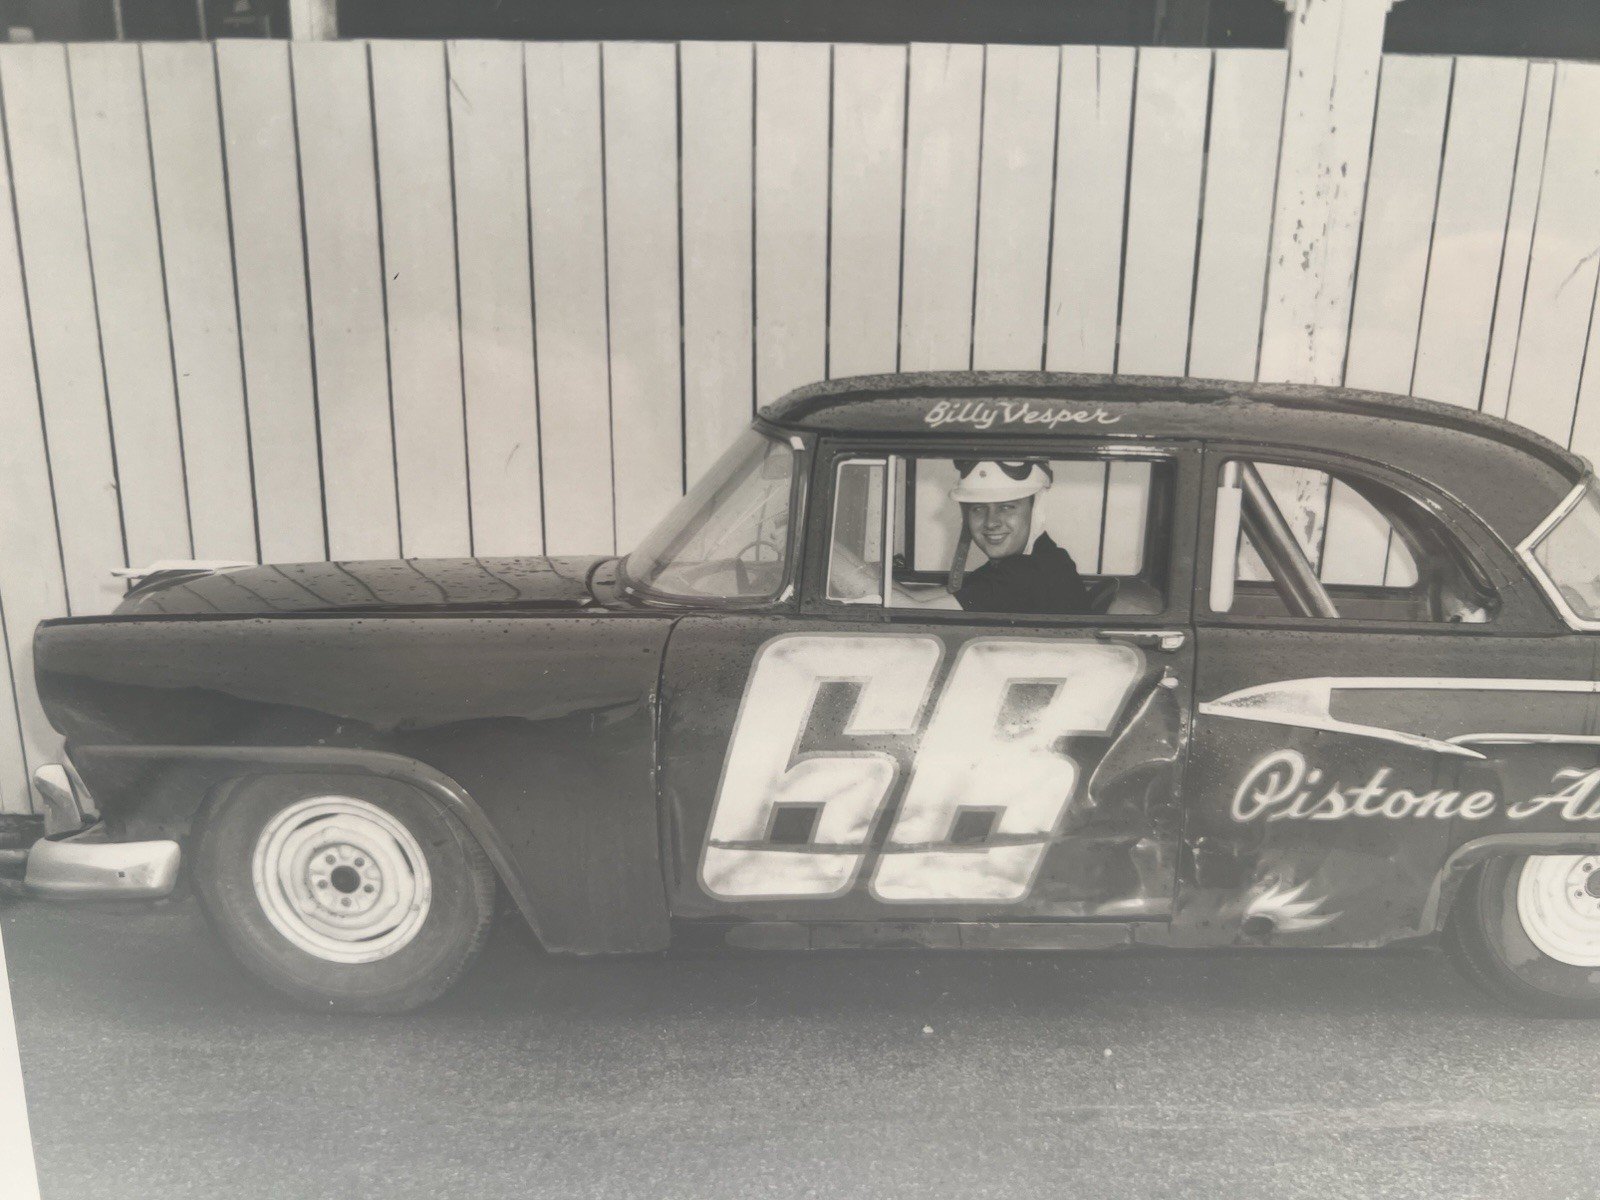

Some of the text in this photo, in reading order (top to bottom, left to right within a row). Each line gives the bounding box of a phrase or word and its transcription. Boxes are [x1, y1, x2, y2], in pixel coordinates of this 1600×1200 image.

[924, 400, 1121, 430] Billy Vesper
[1231, 749, 1496, 823] Pistone
